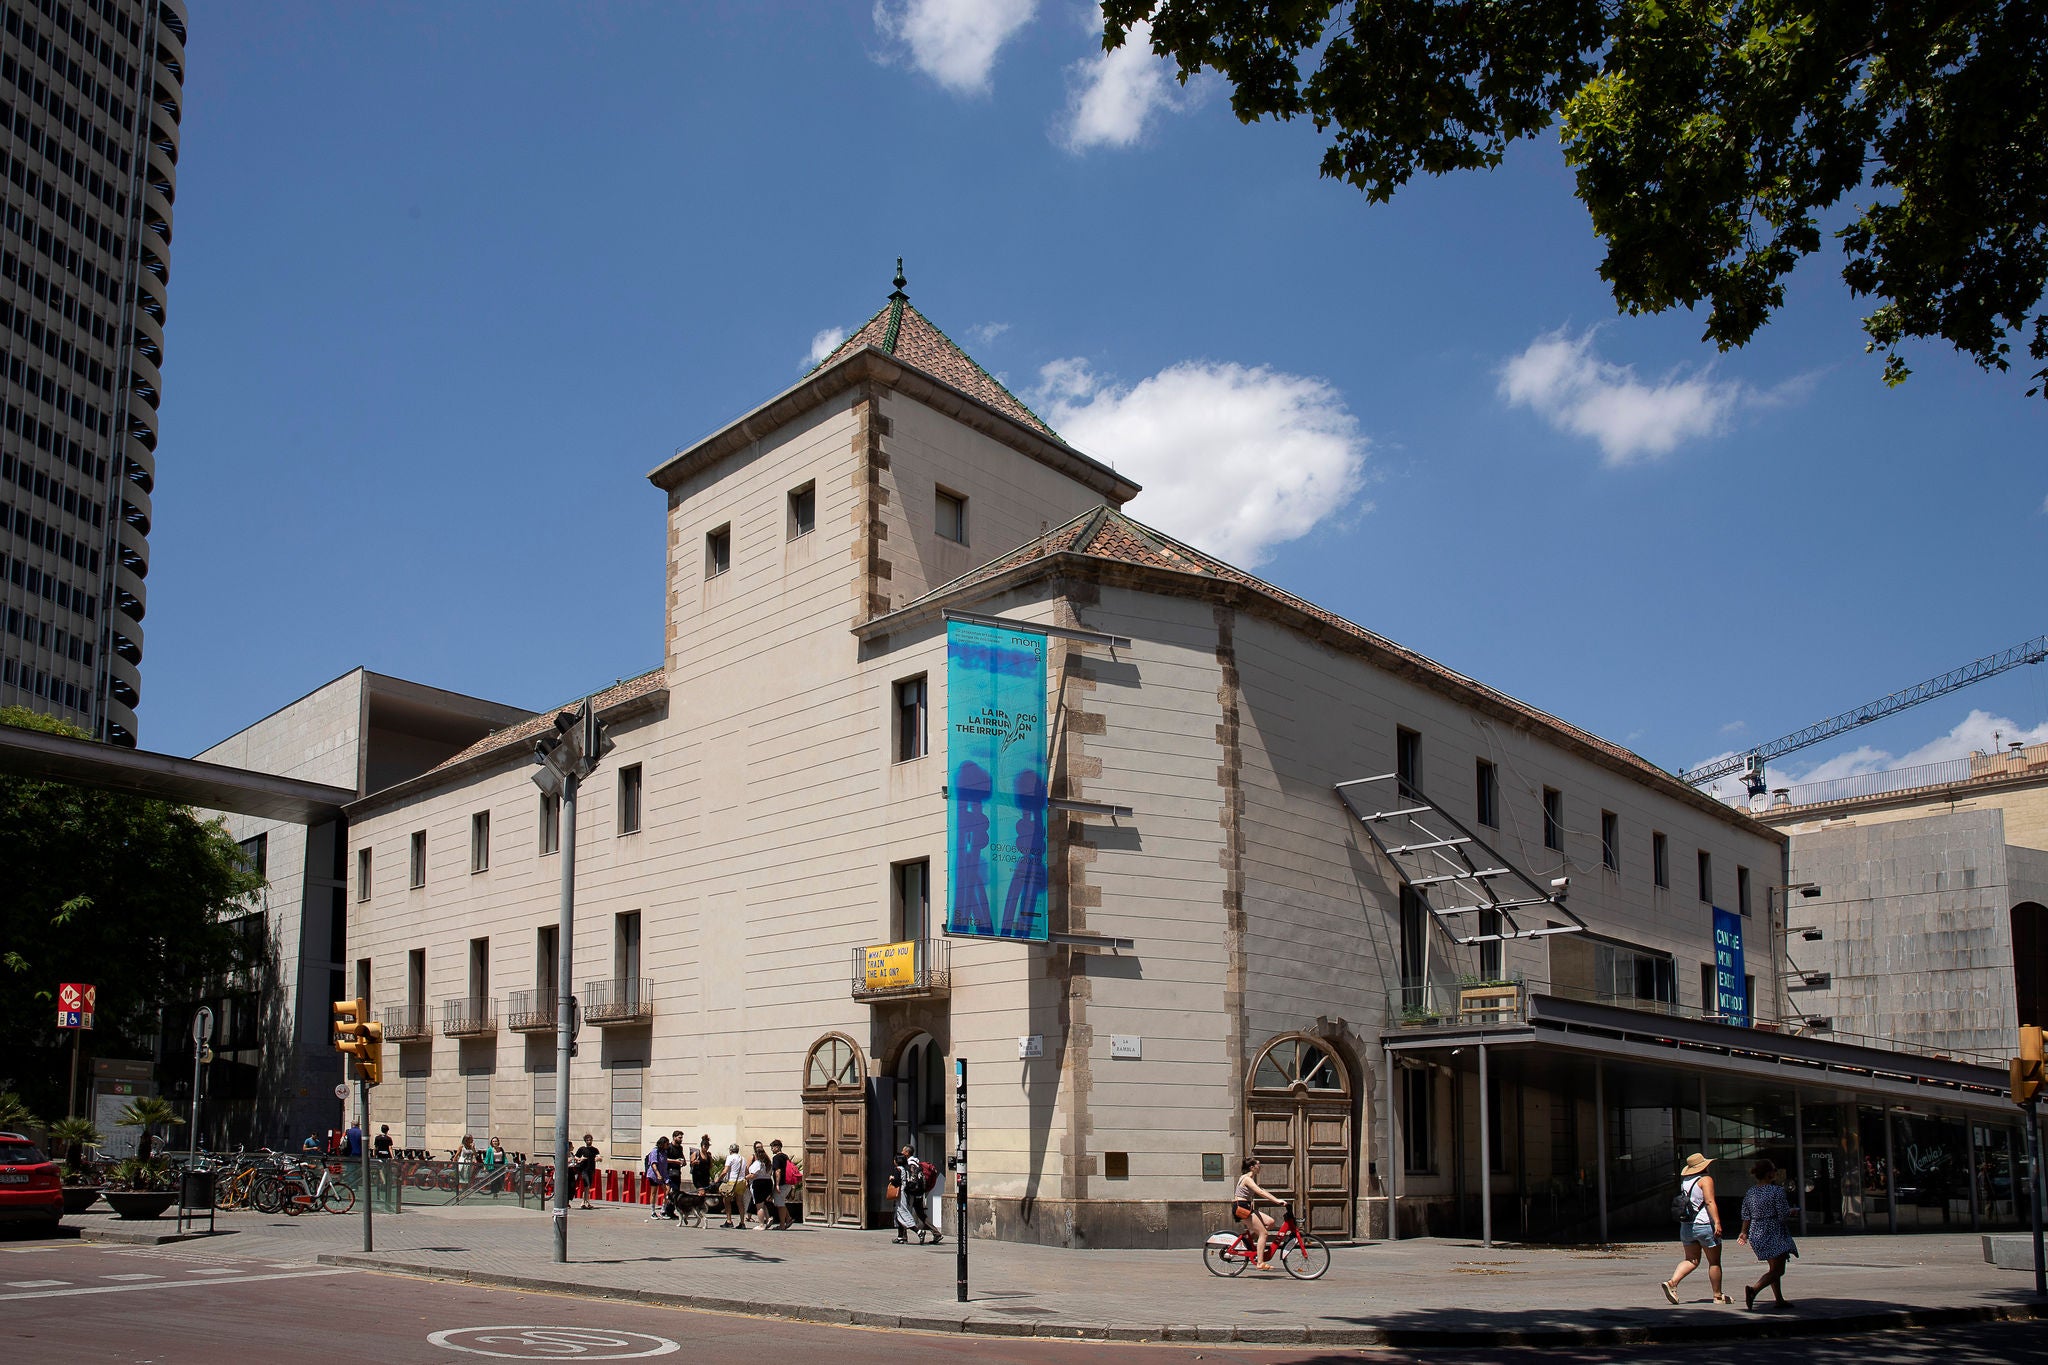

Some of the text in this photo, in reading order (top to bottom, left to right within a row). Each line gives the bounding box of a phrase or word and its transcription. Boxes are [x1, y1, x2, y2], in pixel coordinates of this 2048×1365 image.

[981, 707, 994, 717] LA
[968, 716, 981, 725] LA
[955, 724, 975, 733] THE
[869, 950, 882, 959] WHAT
[898, 947, 908, 956] YOU
[868, 960, 884, 968] TRAIN
[868, 969, 877, 978] THE
[880, 969, 887, 977] AI
[64, 989, 73, 999] M
[476, 1330, 629, 1354] 30
